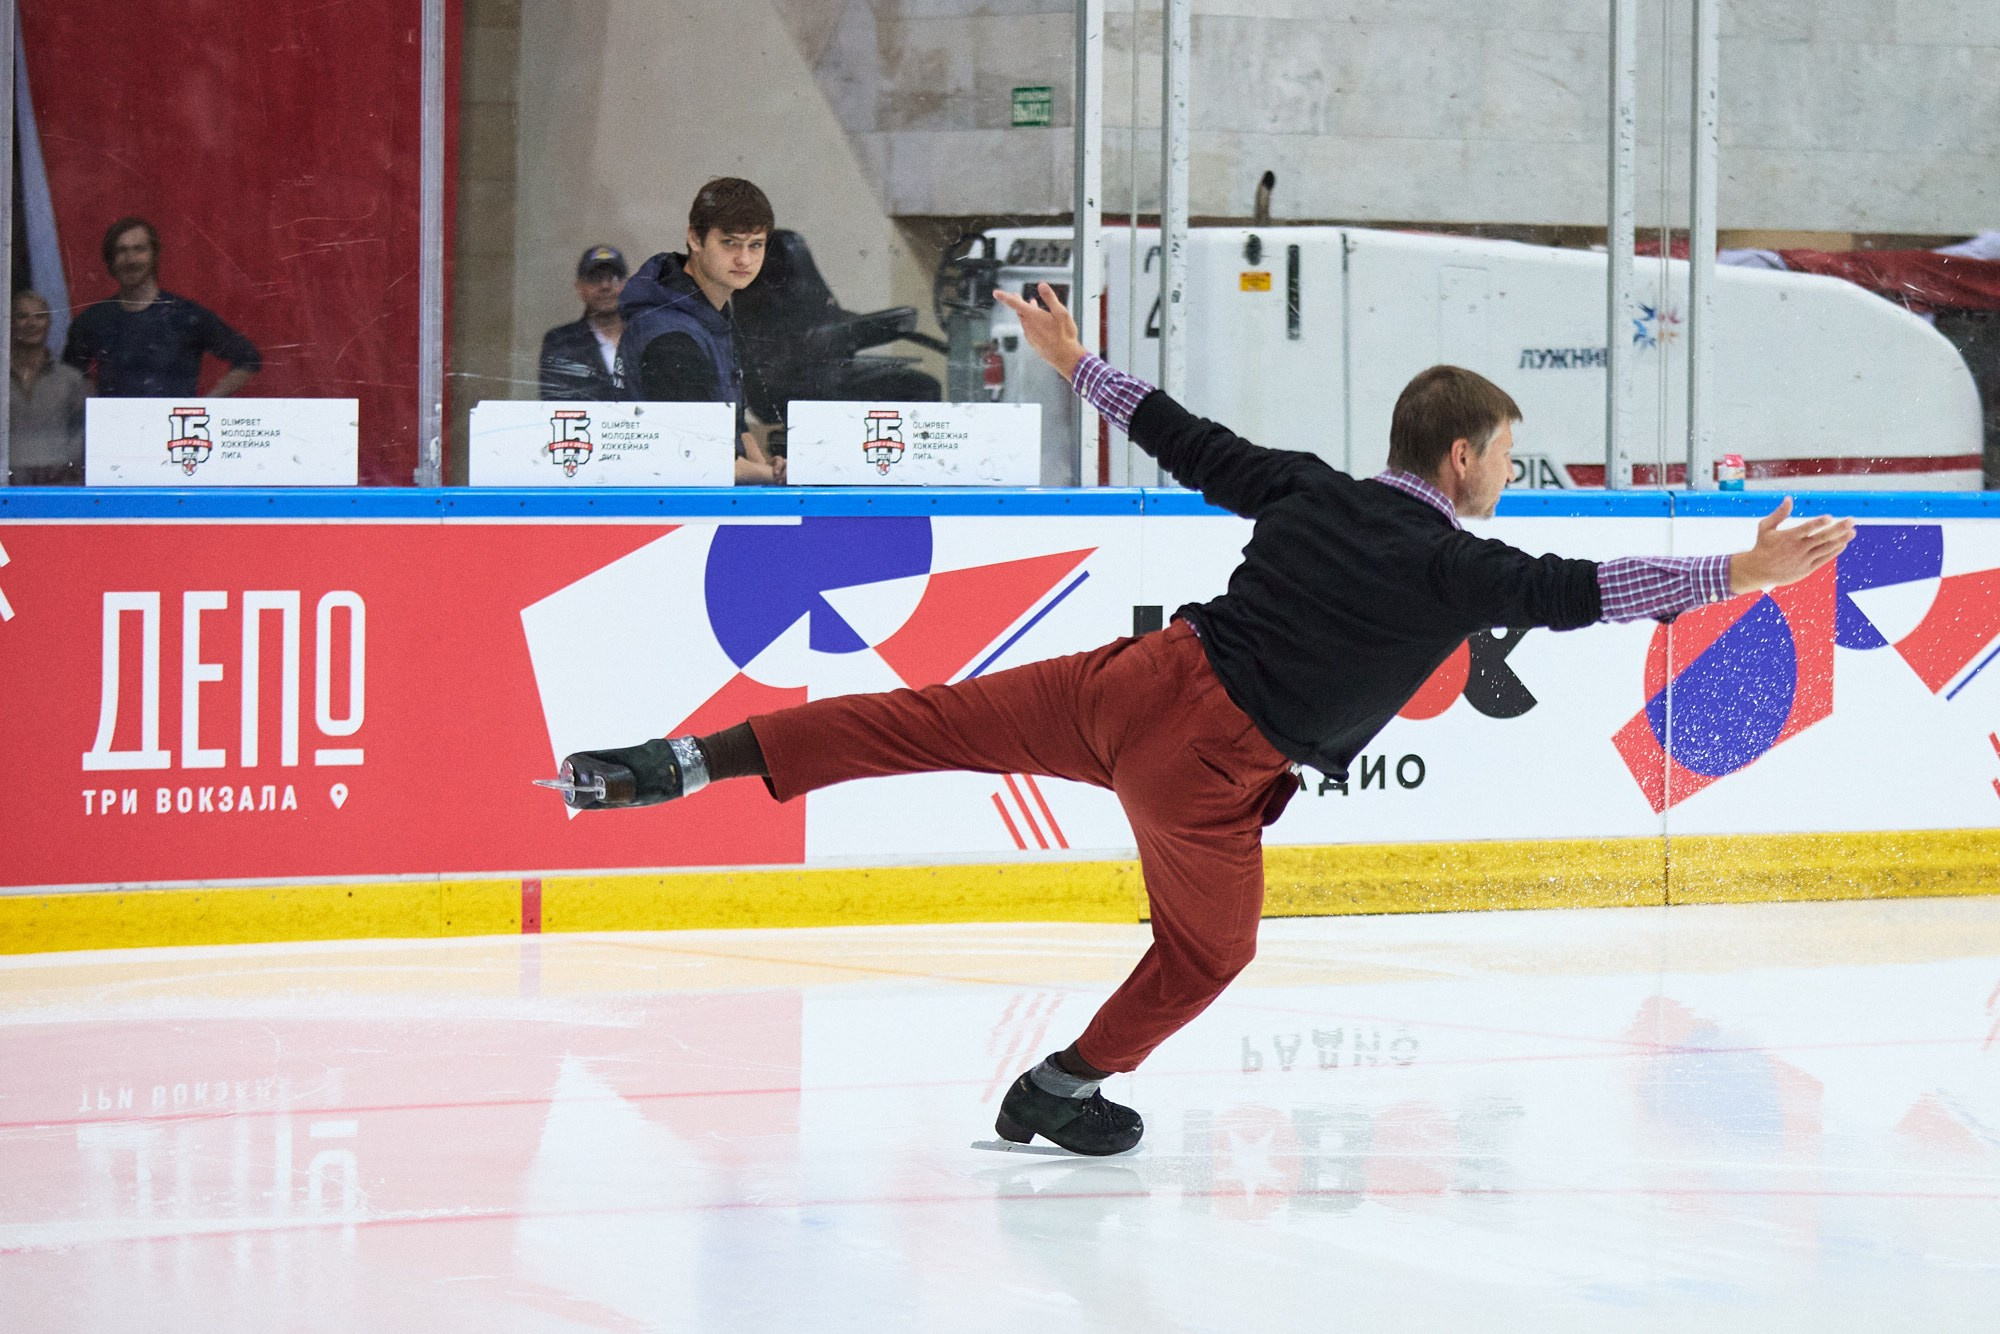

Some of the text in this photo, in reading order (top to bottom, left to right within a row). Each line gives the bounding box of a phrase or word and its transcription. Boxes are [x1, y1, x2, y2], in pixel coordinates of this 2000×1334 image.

[1519, 348, 1608, 370] ЛУЖНИ
[221, 418, 261, 426] OLIMPBET
[601, 421, 640, 429] OLIMPBET
[912, 421, 950, 429] OLIMPBET
[221, 429, 281, 437] МОЛОДЕЖНАЯ
[601, 432, 660, 440] МОЛОДЕЖНАЯ
[221, 439, 270, 448] ХОККЕЙНАЯ
[601, 441, 649, 450] ХОККЕЙНАЯ
[912, 441, 958, 450] ХОККЕЙНАЯ
[221, 451, 242, 459] ЛИГА
[912, 452, 932, 460] ЛИГА
[1505, 459, 1565, 489] PIA
[82, 590, 366, 771] ДЕПО
[82, 785, 298, 816] ТРИ ВОКЗАЛА
